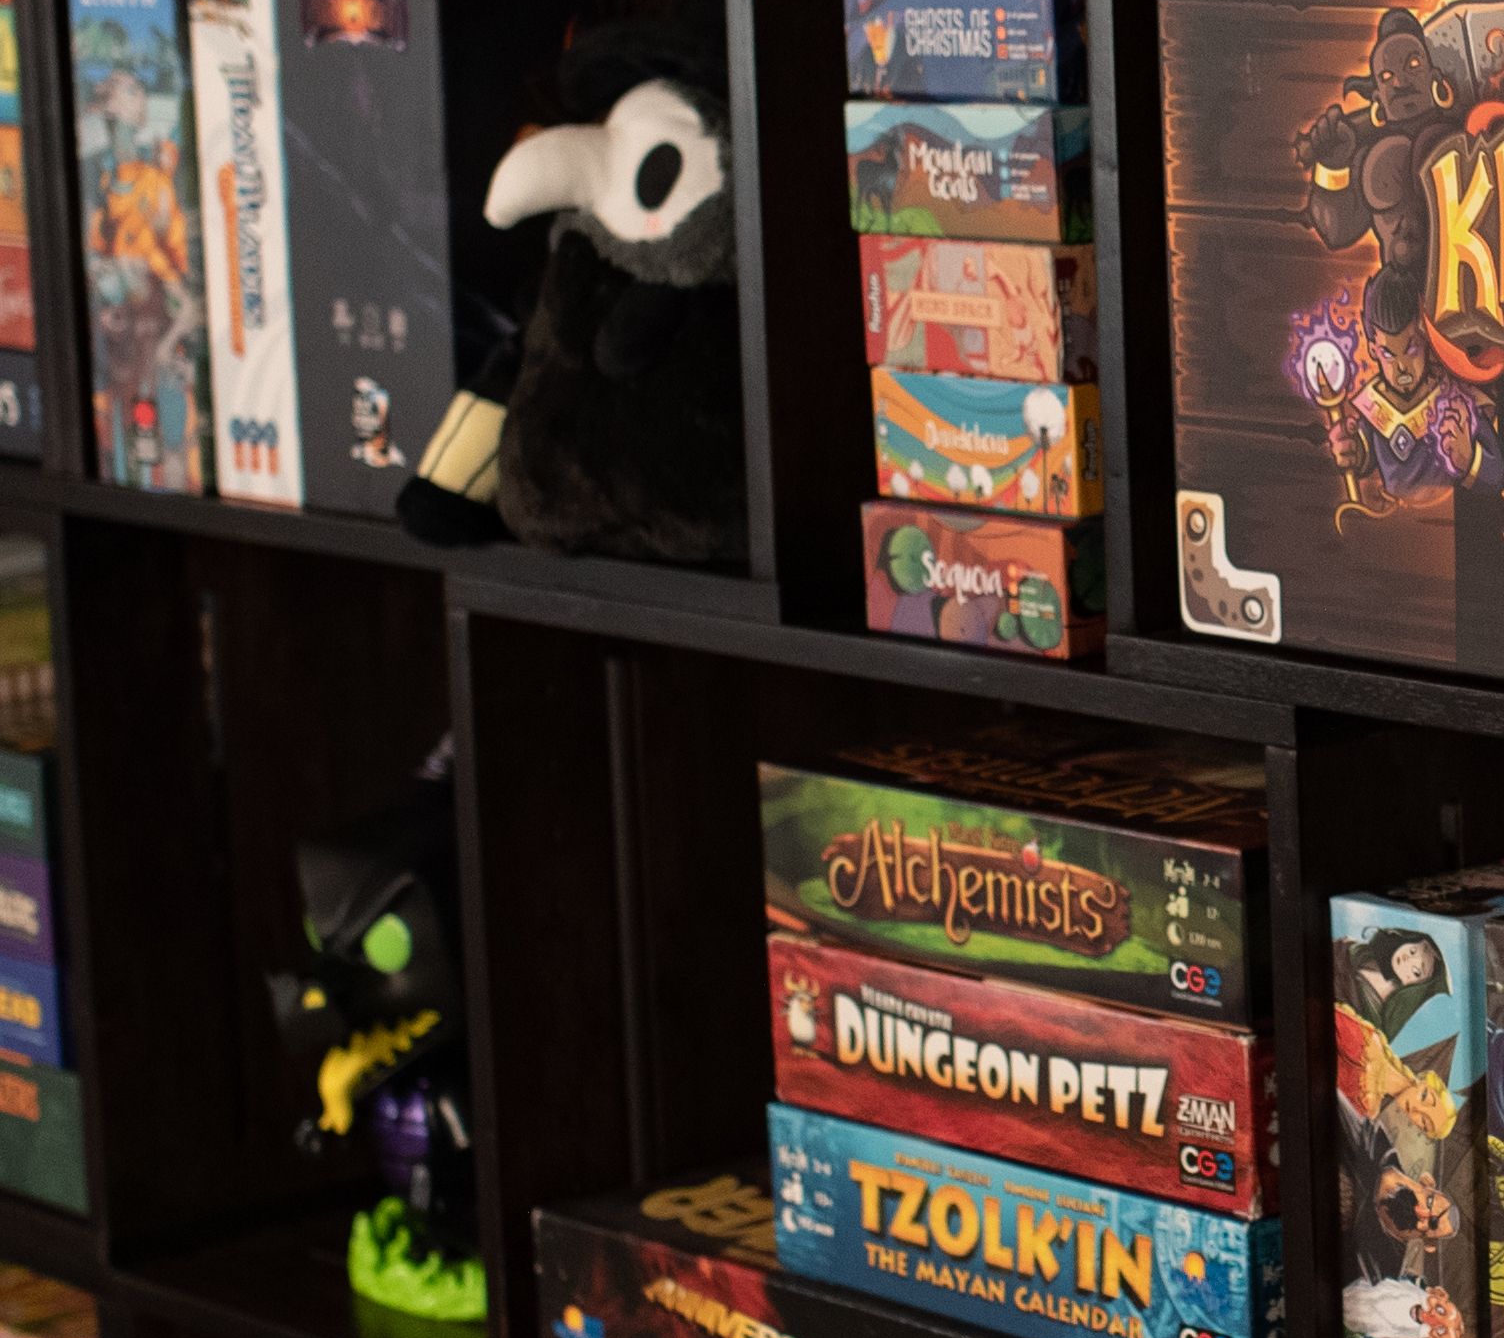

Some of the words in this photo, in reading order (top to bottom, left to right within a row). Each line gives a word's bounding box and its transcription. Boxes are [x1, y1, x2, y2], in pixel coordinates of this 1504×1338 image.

[829, 818, 1118, 946] Alchemists
[833, 992, 1040, 1107] DUNGEON
[1048, 1056, 1171, 1138] PETZ
[849, 1158, 1153, 1311] TZOLK'IN
[865, 1242, 909, 1277] THE
[915, 1258, 1007, 1304] MAYAN
